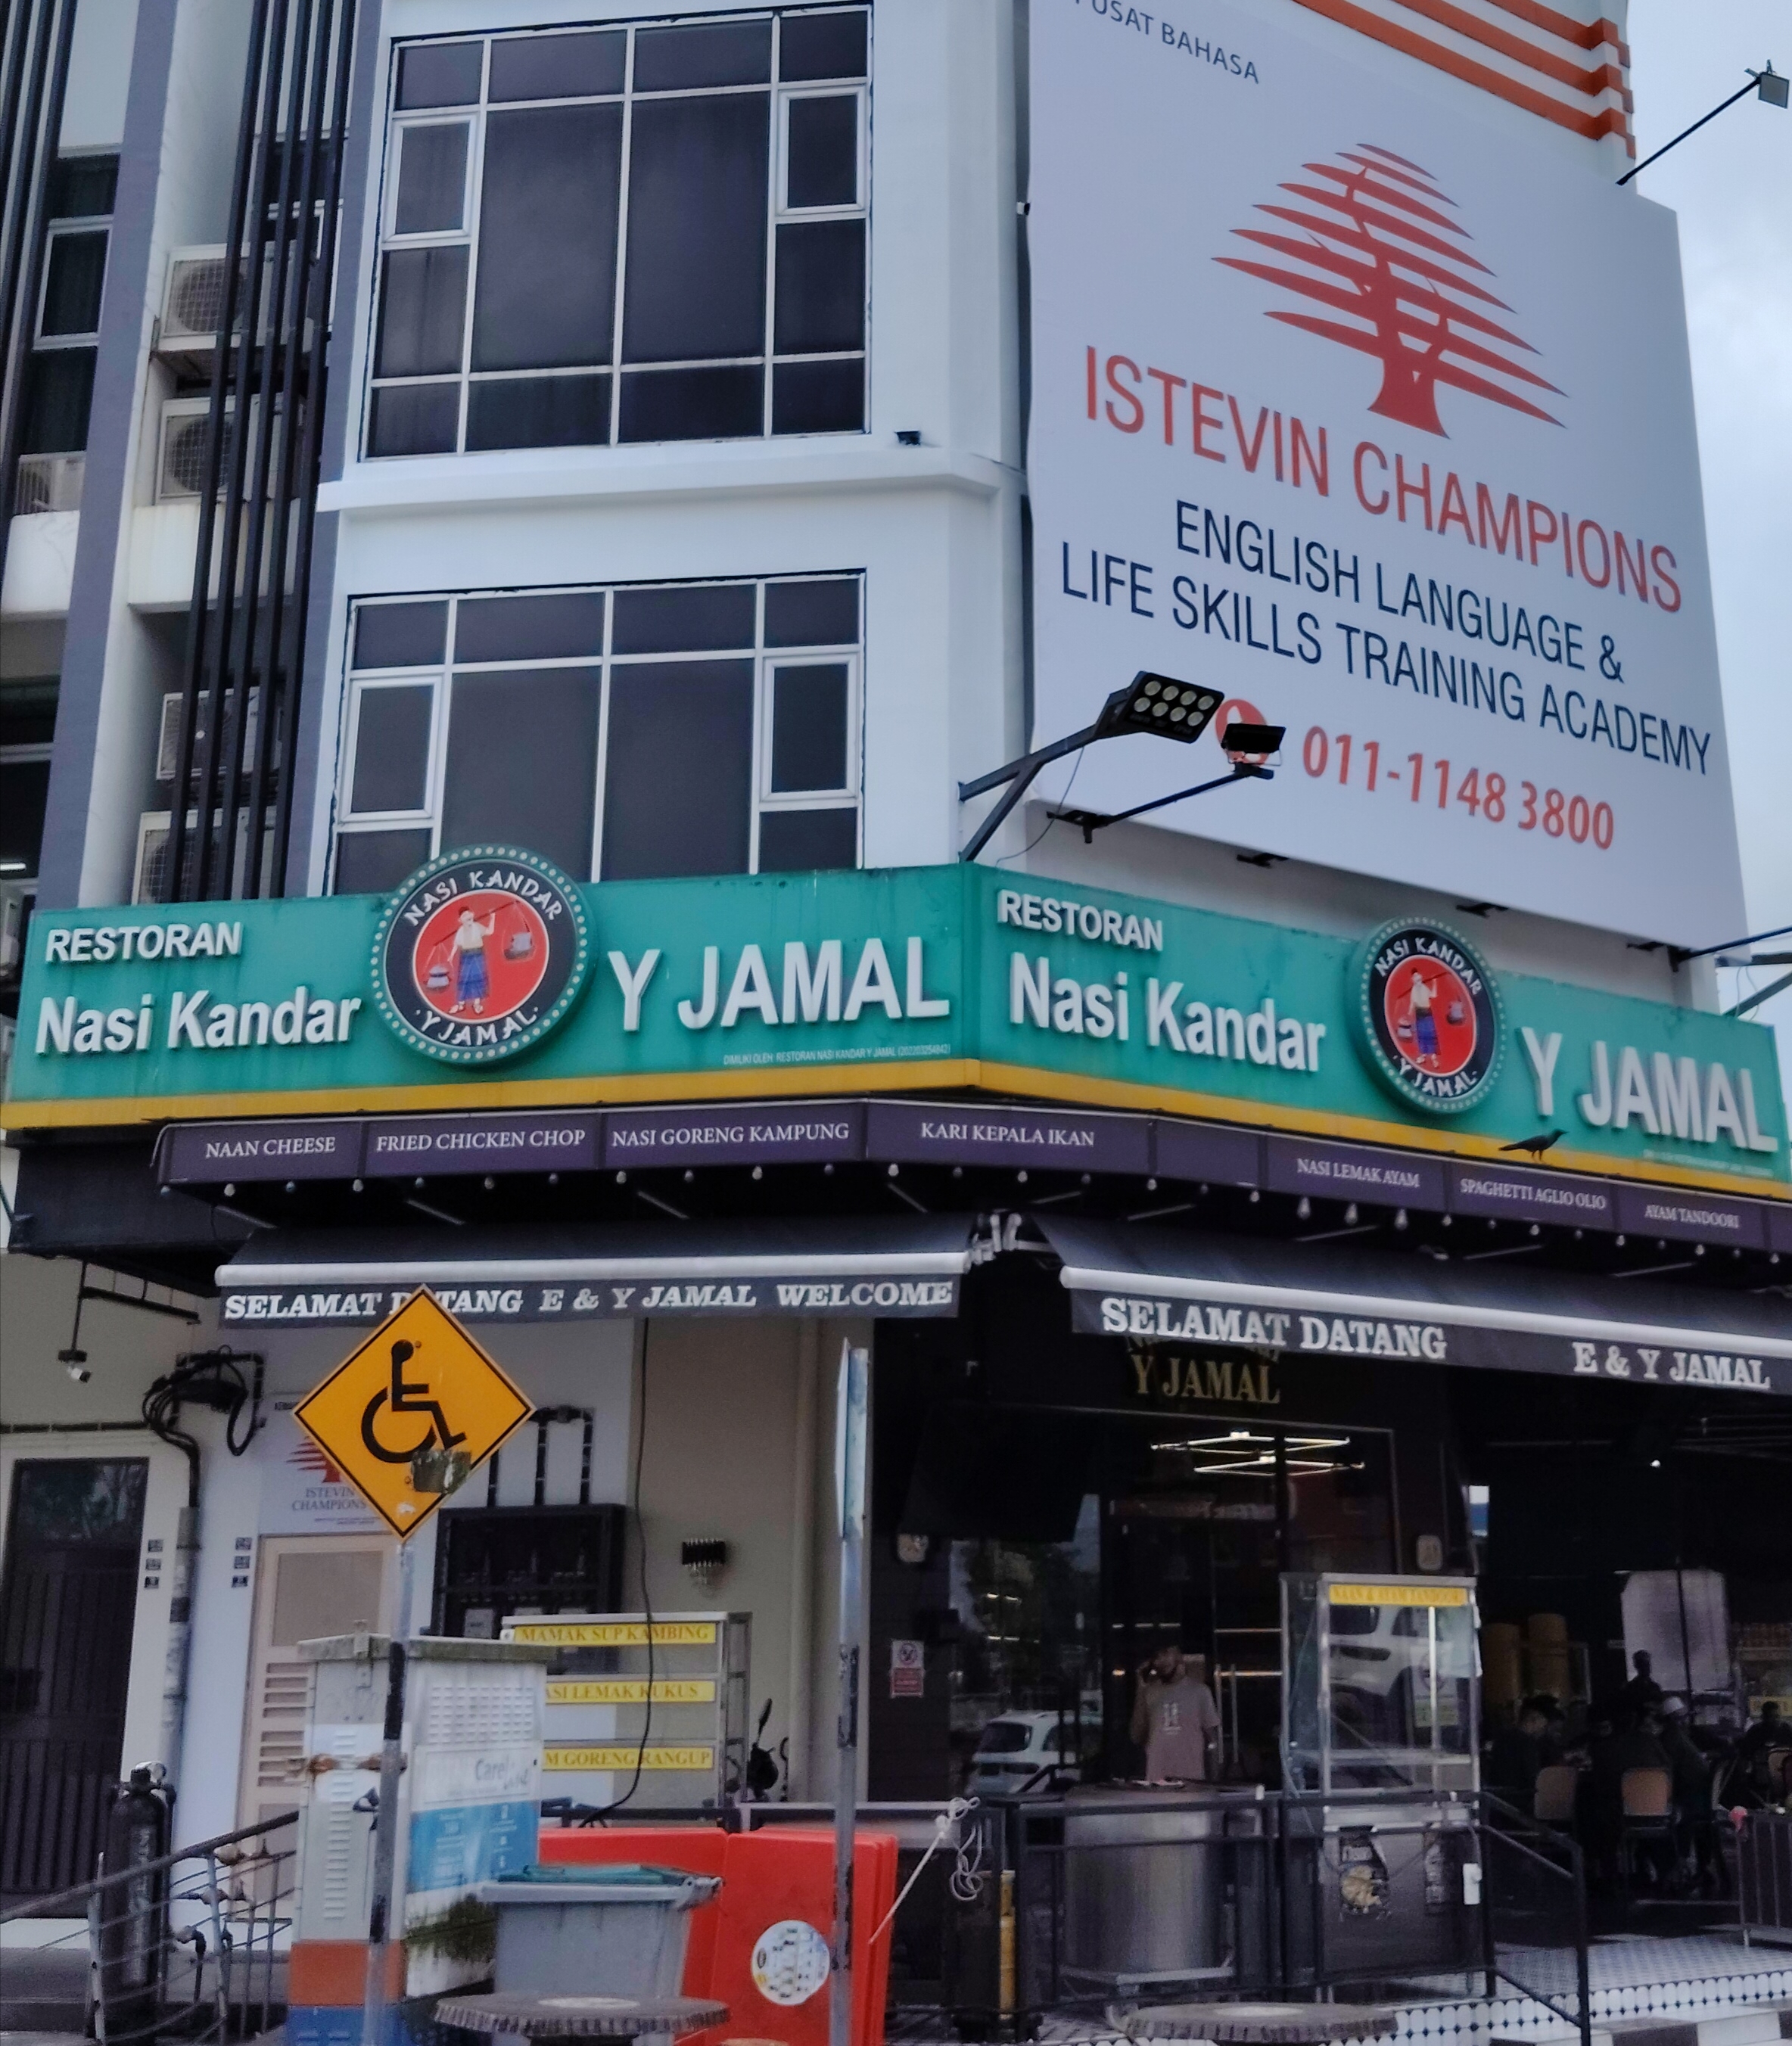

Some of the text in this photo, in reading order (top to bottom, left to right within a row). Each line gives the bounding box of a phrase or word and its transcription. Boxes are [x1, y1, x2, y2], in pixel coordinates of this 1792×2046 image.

[1075, 0, 1258, 84] USAT BAHASA
[1086, 345, 1682, 612] ISTEVIN CHAMPIONS
[1176, 500, 1624, 683] ENGLISH LANGUAGE &
[1062, 542, 1711, 776] LIFE SKILLS TRAINING ACADEMY
[1302, 726, 1615, 850] 011-1148 3800
[404, 870, 562, 926] NASI KANDAR
[997, 889, 1162, 952] RESTORAN
[45, 922, 242, 962] RESTORAN
[608, 936, 950, 1031] Y JAMAL
[1375, 937, 1482, 995] NASI KANDAR
[36, 986, 362, 1055] Nasi Kandar
[421, 1010, 537, 1046] Y JAMAL
[1010, 952, 1326, 1072] Nasi Kandar
[776, 1050, 815, 1062] RESTORAN
[817, 1049, 833, 1061] NASI
[835, 1048, 865, 1059] KANDAR
[873, 1046, 896, 1057] JAMAL
[1400, 1058, 1476, 1097] Y JAMAL
[1519, 1027, 1778, 1153] Y JAMAL
[205, 1136, 335, 1158] NAAN CHEESE
[377, 1129, 586, 1152] FRIED CHICKEN CHOP
[612, 1122, 850, 1146] NASI GORENG KAMPUNG
[921, 1122, 1094, 1146] KARI KEPALA IKAN
[1297, 1158, 1420, 1188] NASI LEMAK AYAM
[1461, 1178, 1607, 1210] SPAGHETTI AGLIO OLIO
[1644, 1205, 1741, 1229] AYAM TANDOORI
[225, 1282, 954, 1320] SELAMAT DTANG E & Y JAMAL WELCOME
[1101, 1298, 1290, 1346] SELAMAT
[1299, 1316, 1446, 1359] DATANG
[1573, 1342, 1598, 1373] E
[1605, 1345, 1629, 1376] &
[1637, 1348, 1660, 1379] Y
[1669, 1351, 1771, 1390] JAMAL
[1131, 1354, 1280, 1404] Y JAMAL
[292, 1499, 366, 1511] CHAMPIONS
[306, 1487, 354, 1497] ISTEVIN
[521, 1626, 708, 1642] MAMAK SUP KAMBING
[572, 1685, 633, 1699] LEMAK
[640, 1684, 697, 1698] KUKUS
[564, 1751, 634, 1765] GORENG
[642, 1751, 710, 1765] RANGUP
